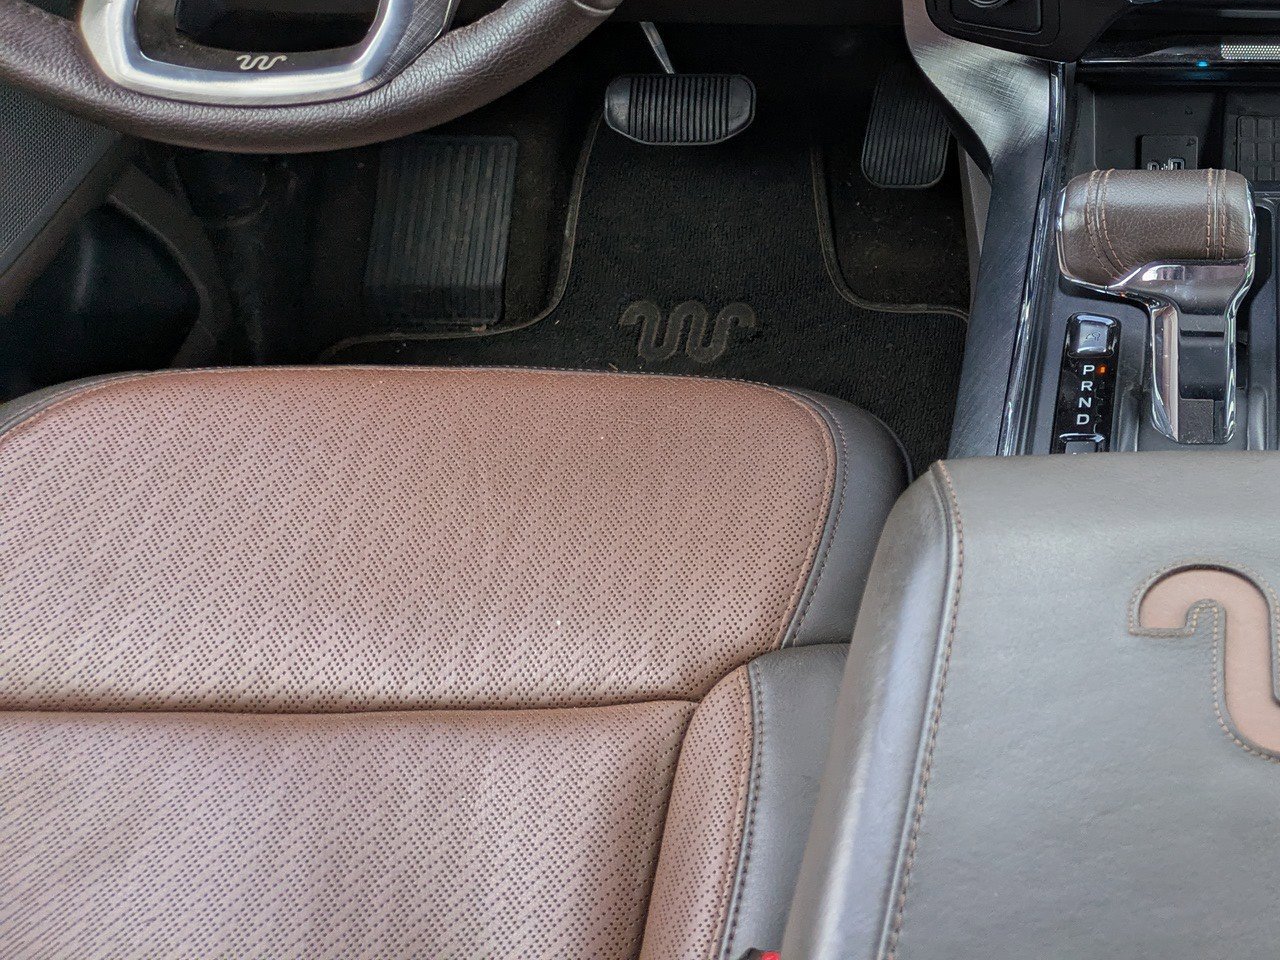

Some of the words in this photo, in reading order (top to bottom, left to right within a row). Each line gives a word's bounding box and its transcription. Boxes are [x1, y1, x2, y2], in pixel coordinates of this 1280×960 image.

[1083, 365, 1095, 375] P
[1081, 381, 1093, 391] R
[1078, 397, 1092, 408] N
[1077, 414, 1090, 425] D
